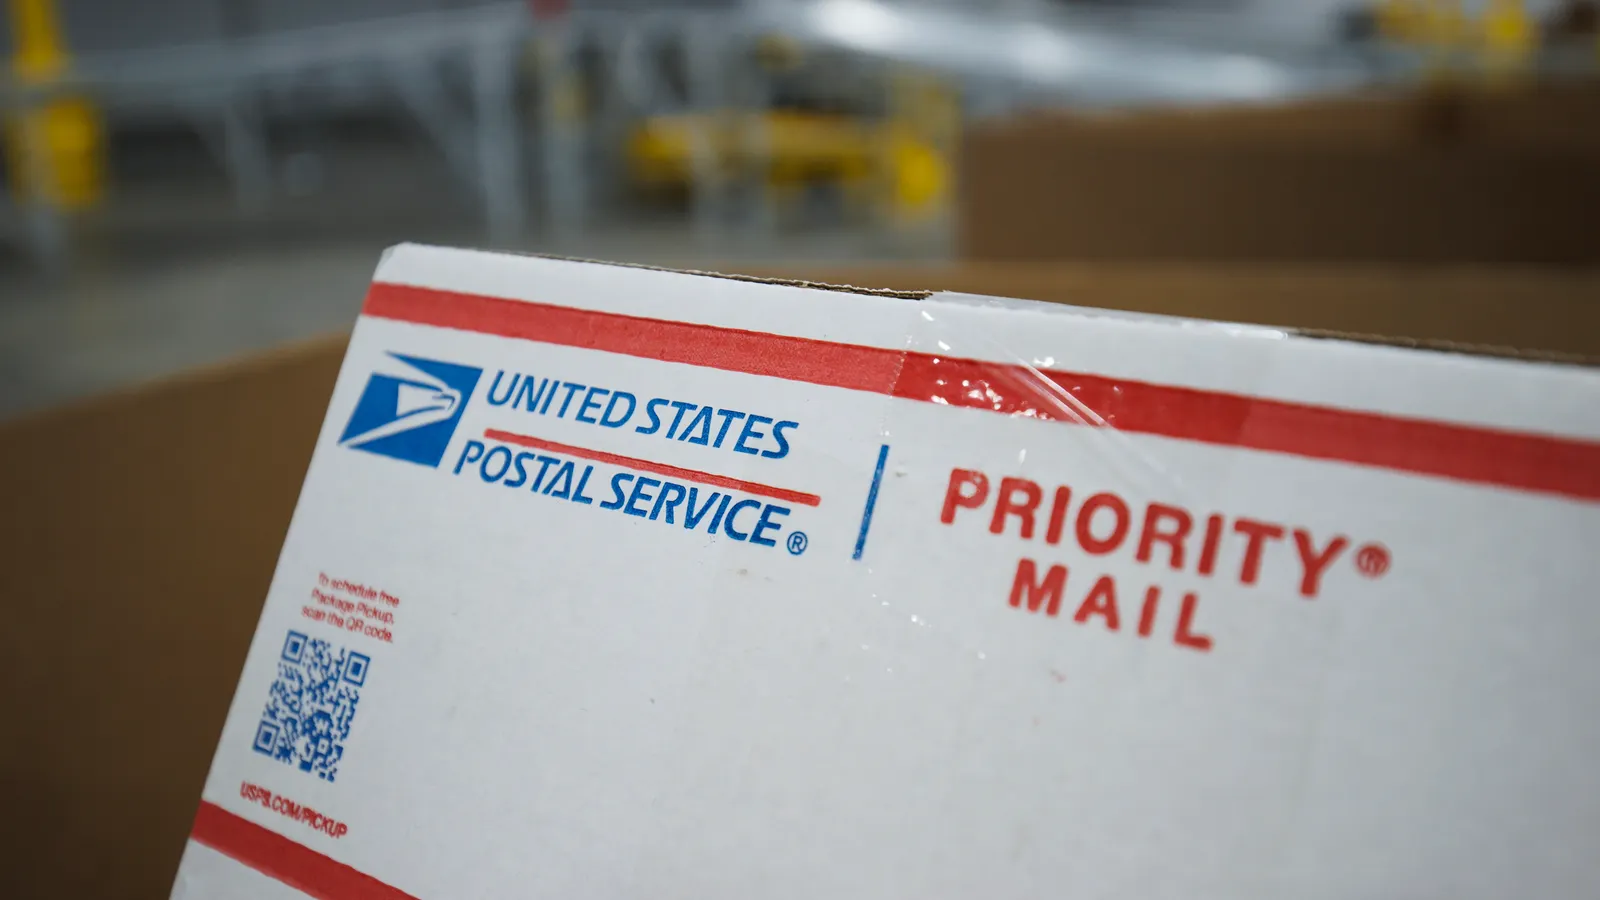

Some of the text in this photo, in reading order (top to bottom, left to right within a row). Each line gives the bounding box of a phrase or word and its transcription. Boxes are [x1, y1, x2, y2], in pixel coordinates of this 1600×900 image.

[486, 370, 799, 459] UNITED STATES
[453, 440, 593, 505] POSTAL
[301, 606, 326, 621] scan
[327, 612, 345, 628] the
[345, 616, 364, 632] QR
[312, 588, 355, 613] Package
[331, 579, 377, 600] schedule
[379, 591, 400, 607] free
[1008, 558, 1214, 652] MAIL
[240, 781, 348, 838] USPS.COM/PICKUP
